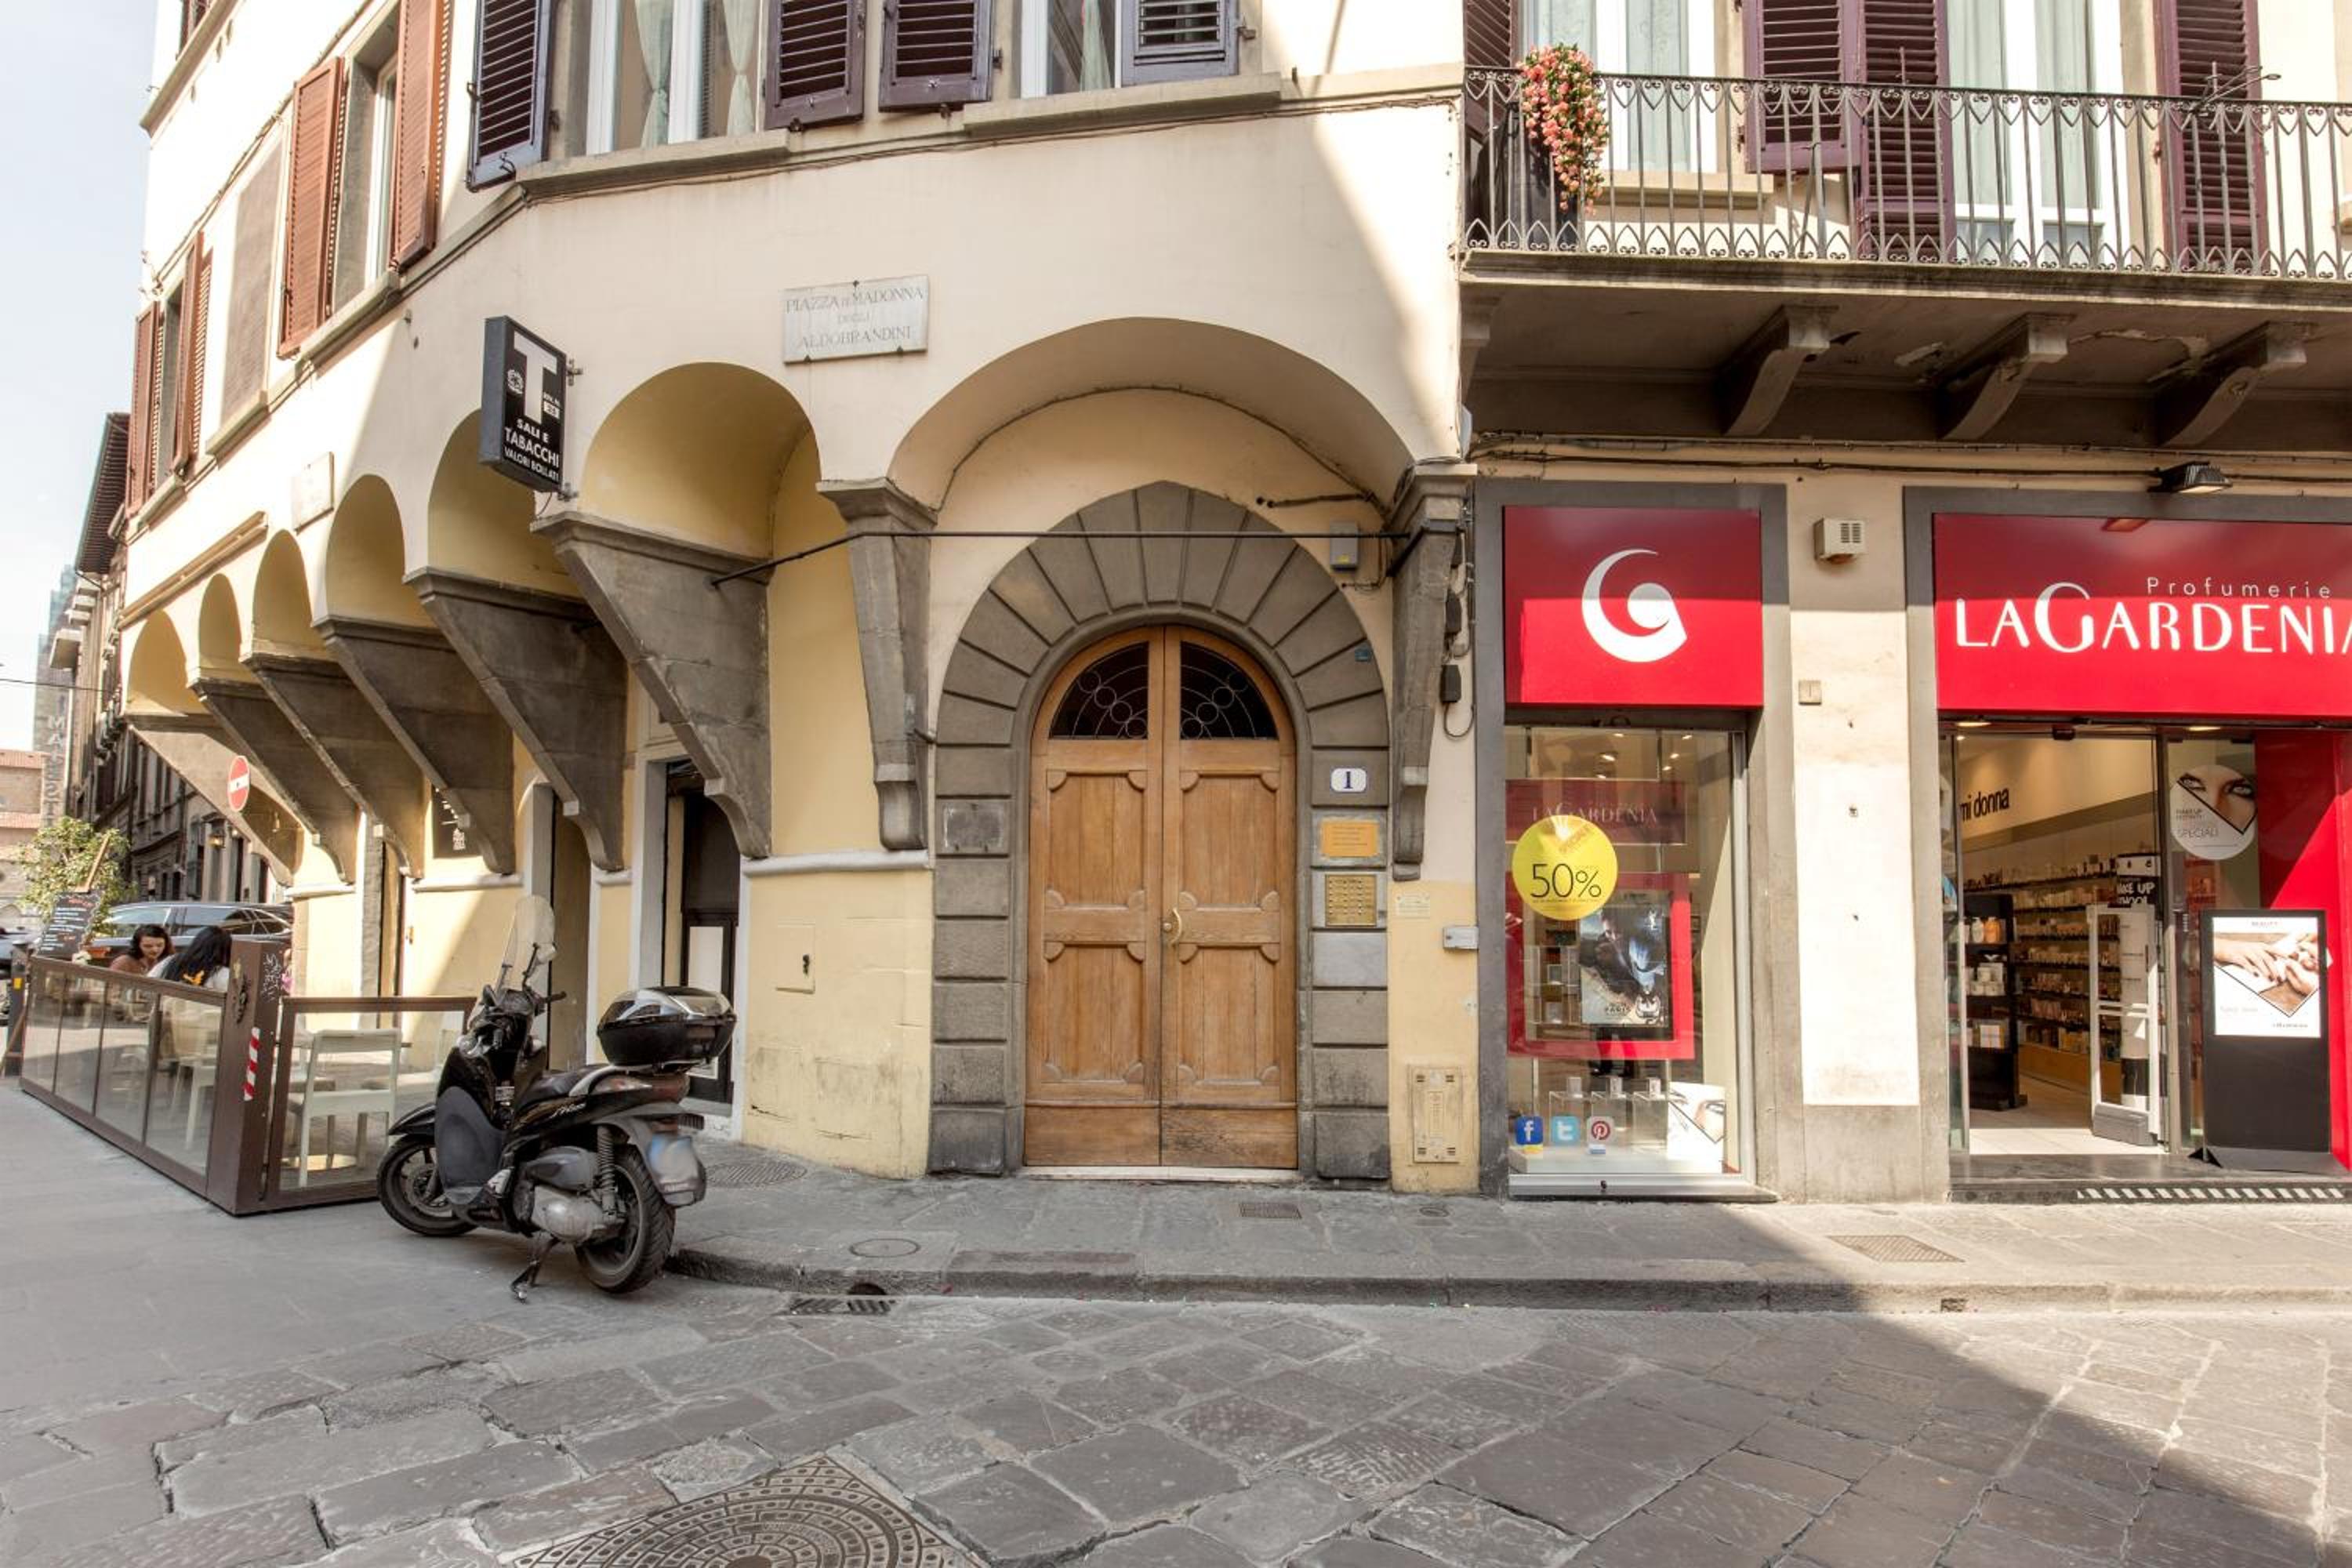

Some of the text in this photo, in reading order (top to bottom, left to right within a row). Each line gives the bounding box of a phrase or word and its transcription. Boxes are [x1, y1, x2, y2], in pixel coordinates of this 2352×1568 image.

[786, 295, 840, 314] PIAZZA
[852, 287, 924, 304] MADONNA
[800, 325, 911, 349] ALDOBRANDINI
[517, 418, 549, 443] SALI E
[504, 426, 559, 469] TABACCHI
[504, 446, 559, 482] VALORI BOLLATI
[2147, 576, 2332, 600] Profumerie
[1956, 582, 2352, 655] LAGARDENI
[1974, 788, 2010, 818] donna
[1530, 863, 1602, 898] 50%
[2137, 881, 2155, 895] UP
